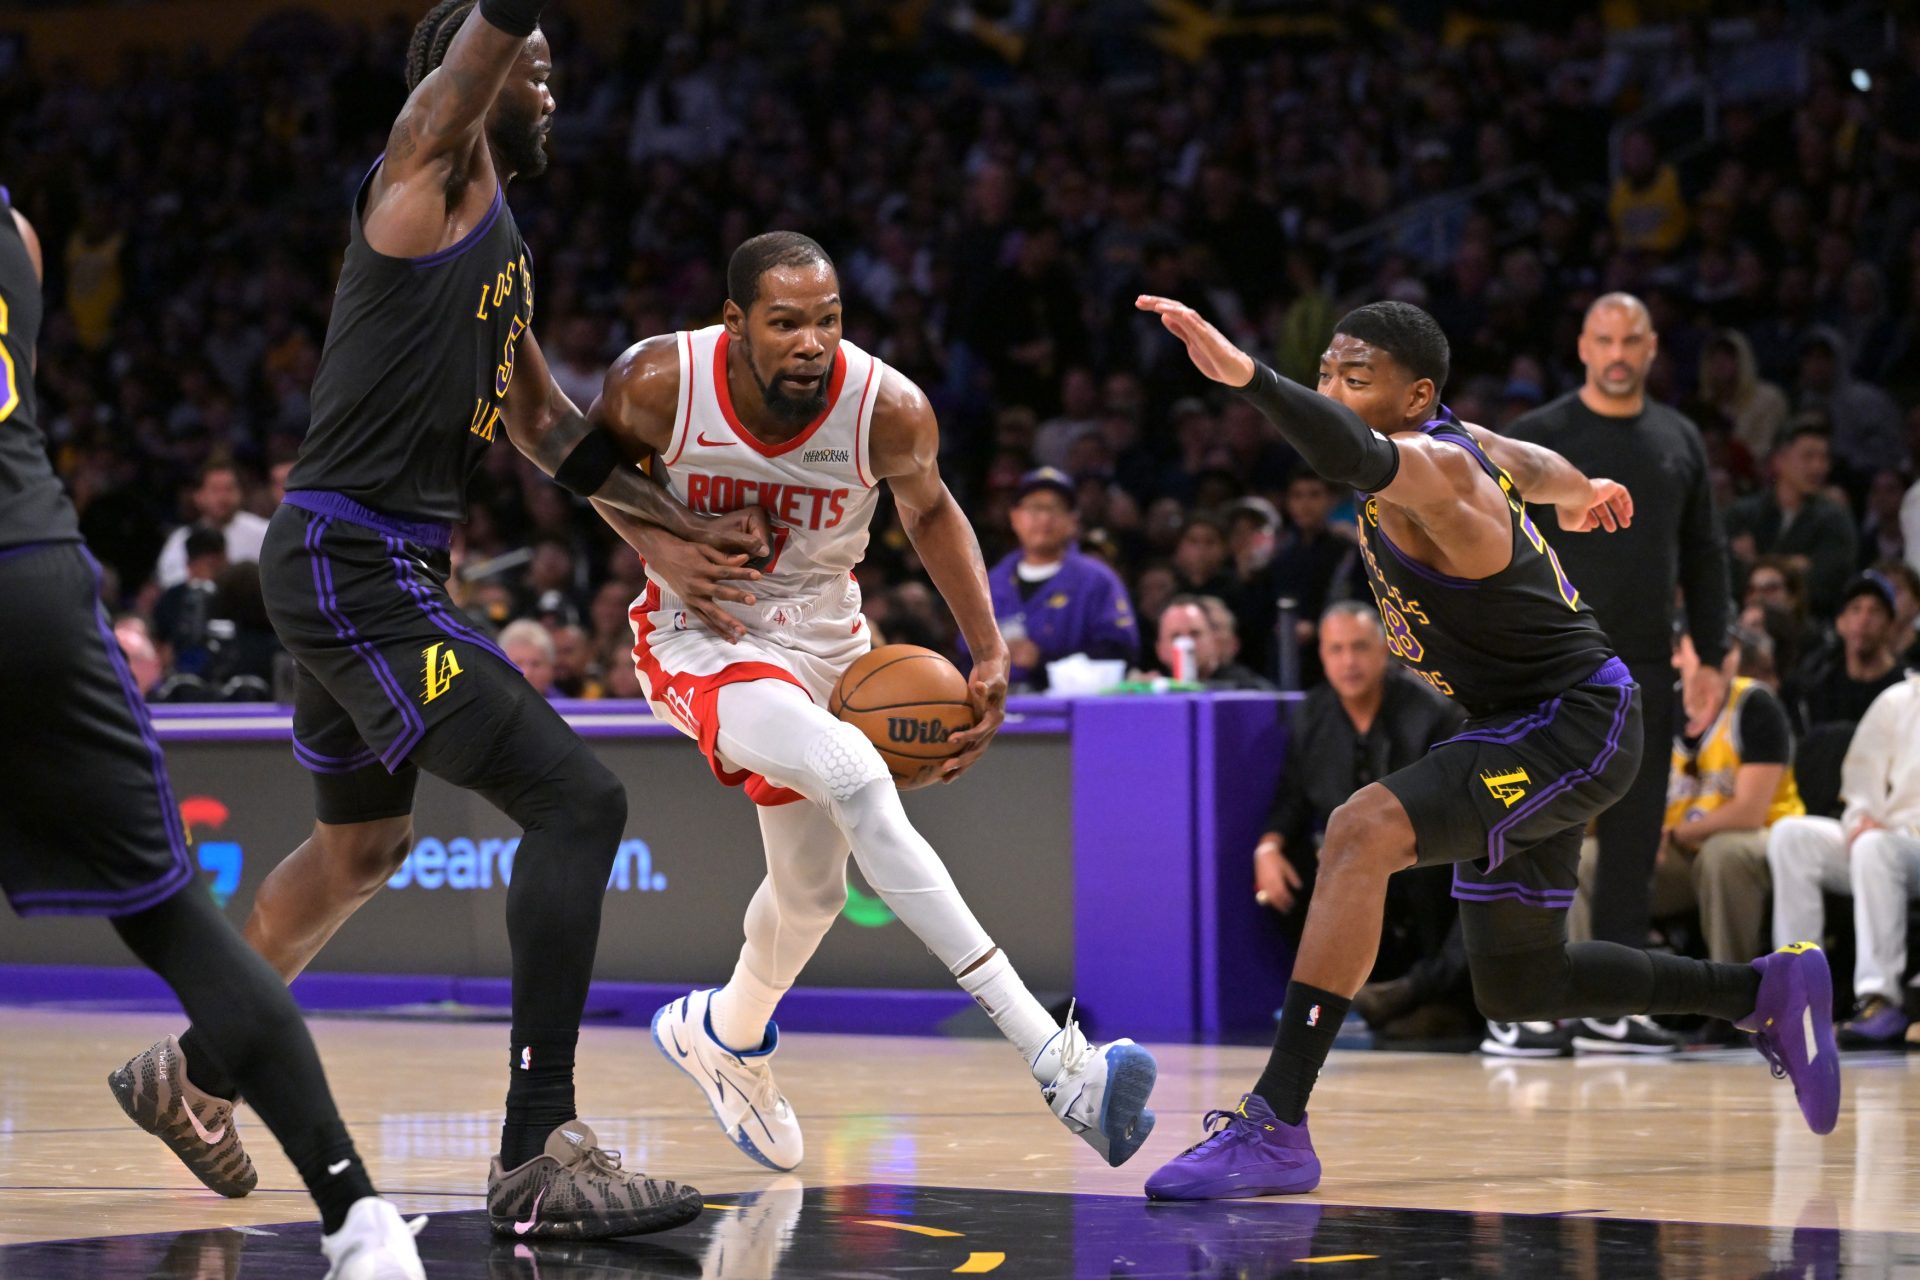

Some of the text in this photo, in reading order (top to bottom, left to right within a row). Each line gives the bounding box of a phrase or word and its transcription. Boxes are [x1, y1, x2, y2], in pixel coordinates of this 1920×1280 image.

[477, 262, 516, 320] LOS
[496, 314, 526, 398] 5
[804, 449, 849, 458] MEMORIAL
[688, 473, 849, 530] ROCKETS
[419, 642, 464, 704] LA
[887, 717, 972, 743] Wils
[1480, 766, 1531, 809] LA
[605, 838, 667, 891] n.
[159, 1049, 167, 1080] TWELVE
